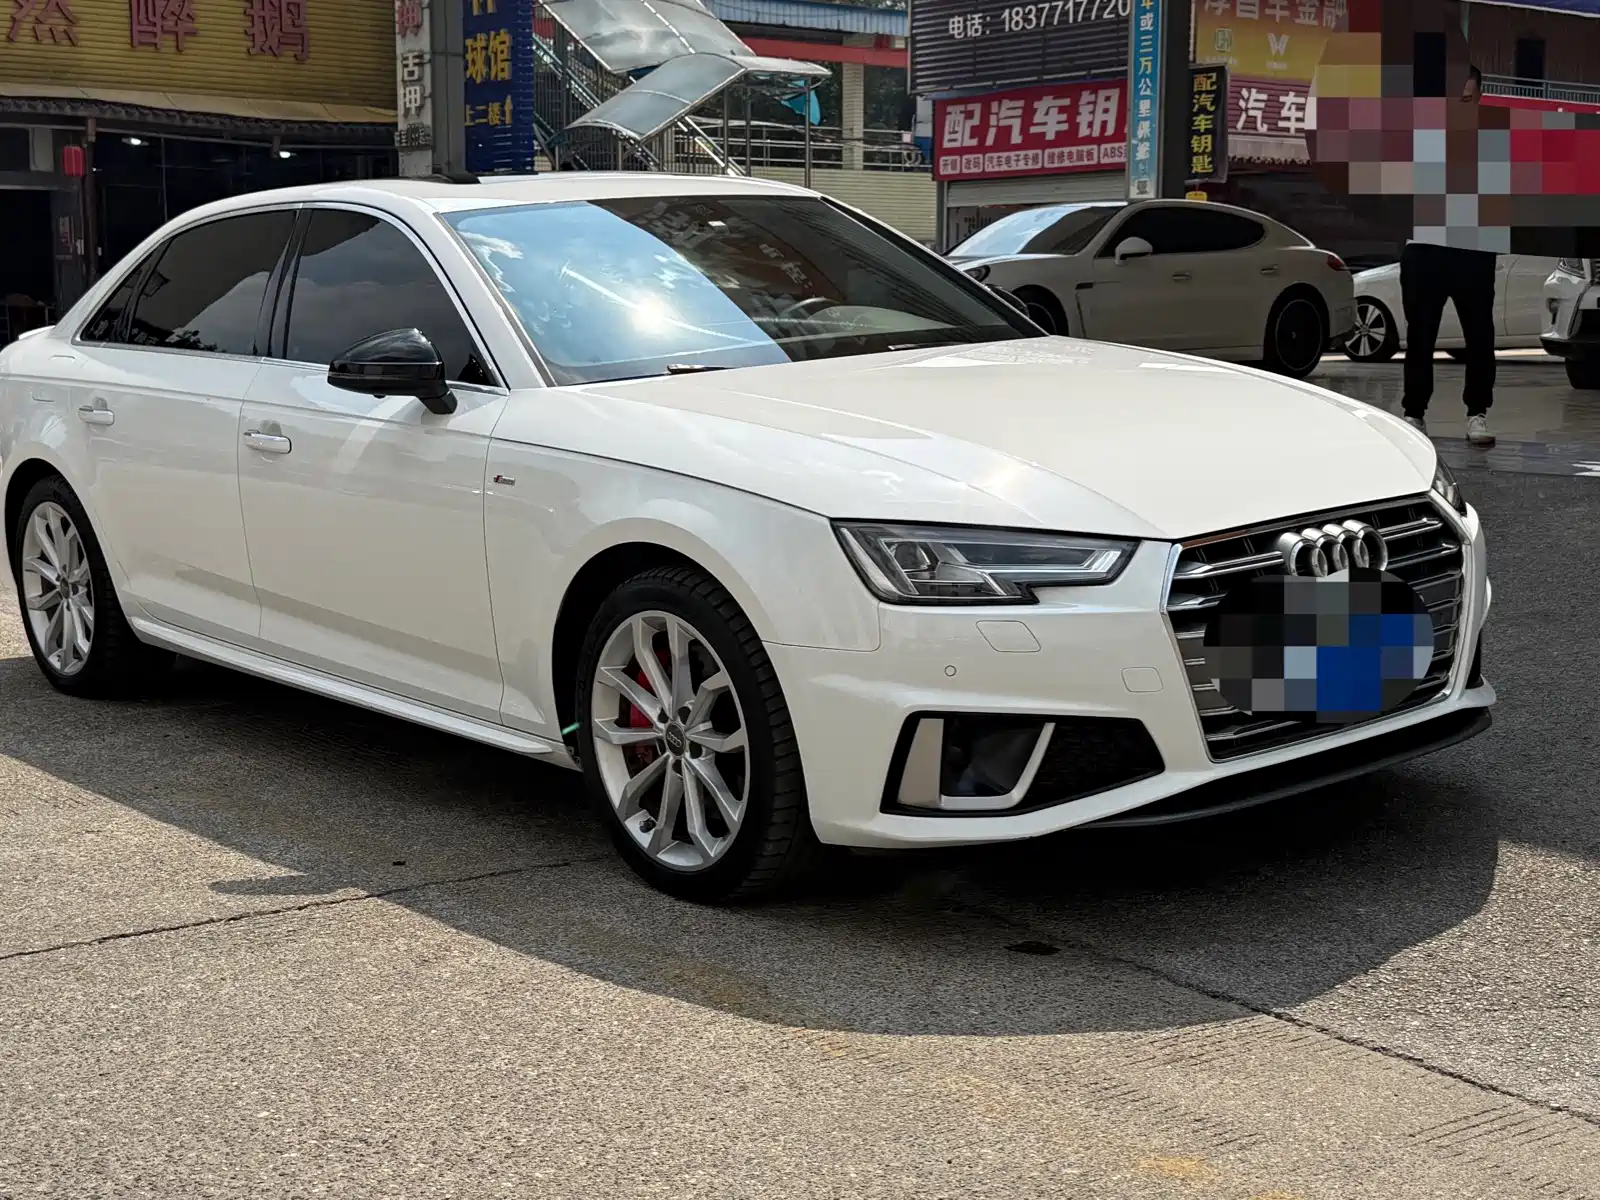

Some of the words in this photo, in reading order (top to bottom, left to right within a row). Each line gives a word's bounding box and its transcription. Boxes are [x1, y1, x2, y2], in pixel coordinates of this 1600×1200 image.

[465, 28, 512, 84] 球馆
[942, 88, 1127, 149] 配汽车钥
[1191, 72, 1218, 174] 配汽车钥匙
[1236, 87, 1305, 135] 汽车
